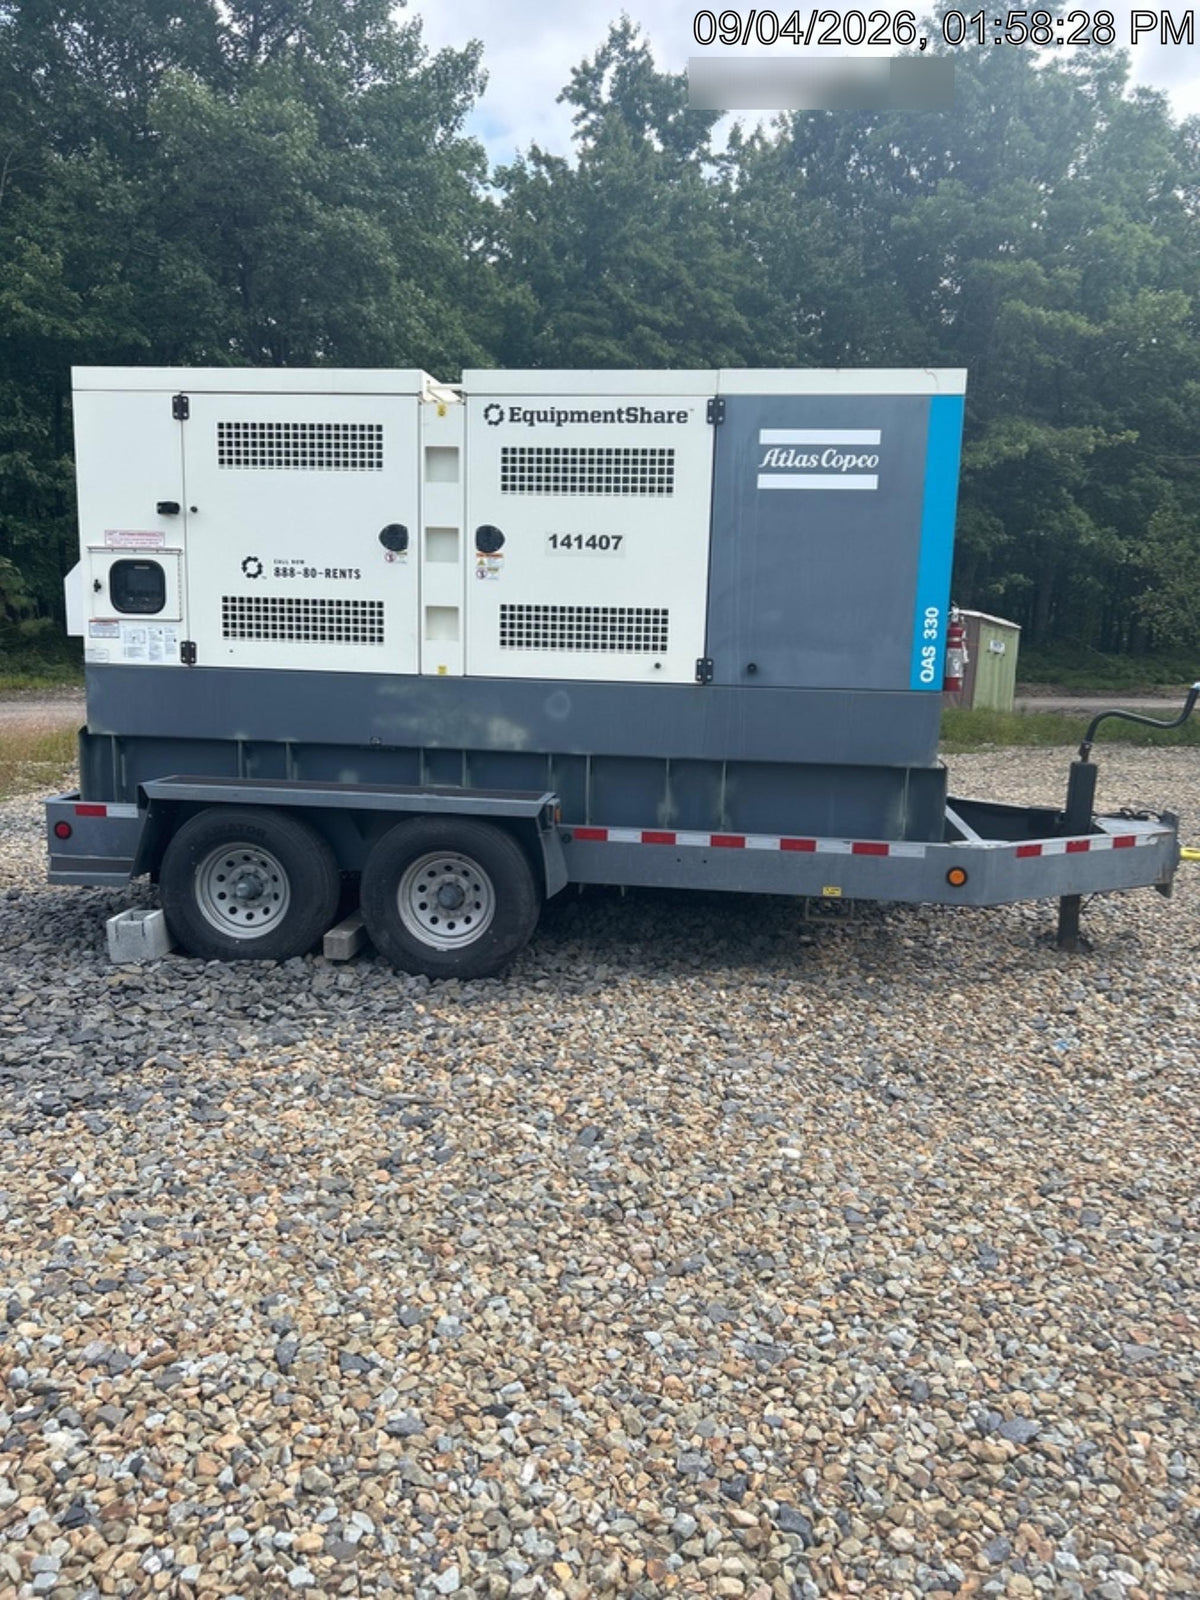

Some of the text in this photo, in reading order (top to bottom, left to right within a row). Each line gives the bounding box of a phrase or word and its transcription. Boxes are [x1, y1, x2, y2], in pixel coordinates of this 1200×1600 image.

[509, 406, 689, 427] EquipmentShare
[758, 447, 879, 472] Atlas Copco
[548, 533, 623, 551] 141407
[273, 566, 362, 580] 888-80-RENTS
[923, 606, 939, 640] 330
